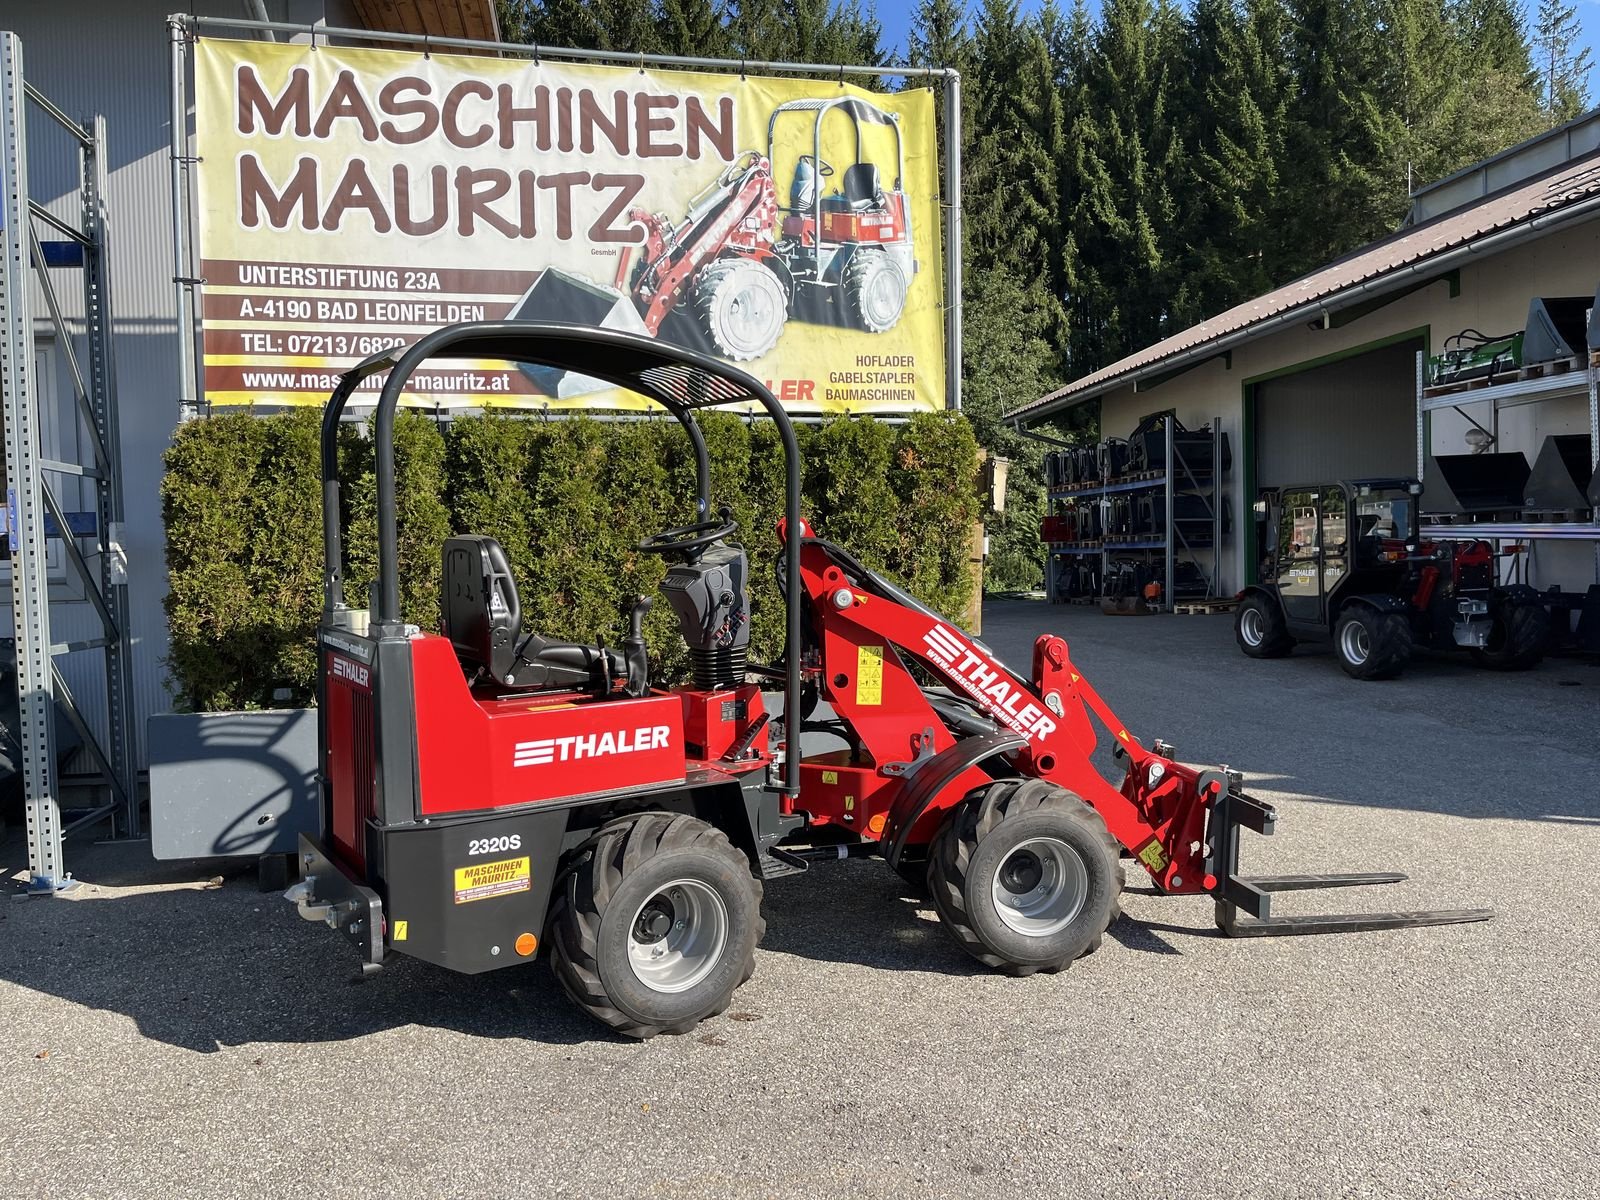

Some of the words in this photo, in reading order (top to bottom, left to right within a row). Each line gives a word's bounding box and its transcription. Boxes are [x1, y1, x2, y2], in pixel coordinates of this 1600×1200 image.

[238, 65, 735, 162] MASCHINEN
[239, 154, 646, 243] MAURITZ
[238, 265, 399, 290] UNTERSTIFTUNG
[404, 271, 441, 291] 23A
[240, 298, 311, 319] A-4190
[317, 300, 358, 320] BAD
[364, 302, 485, 323] LEONFELDEN
[241, 333, 283, 353] TEL:
[856, 355, 915, 368] HOFLADER
[829, 371, 915, 384] GABELSTAPLER
[825, 388, 916, 401] BAUMASCHINEN
[342, 660, 369, 688] THALER
[925, 648, 1033, 741] www.maschinen-mauritz.at
[957, 650, 1057, 742] THALER
[556, 725, 670, 761] THALER
[468, 834, 522, 855] 2320S
[464, 860, 523, 879] MASCHINEN
[472, 870, 516, 887] MAURITZ
